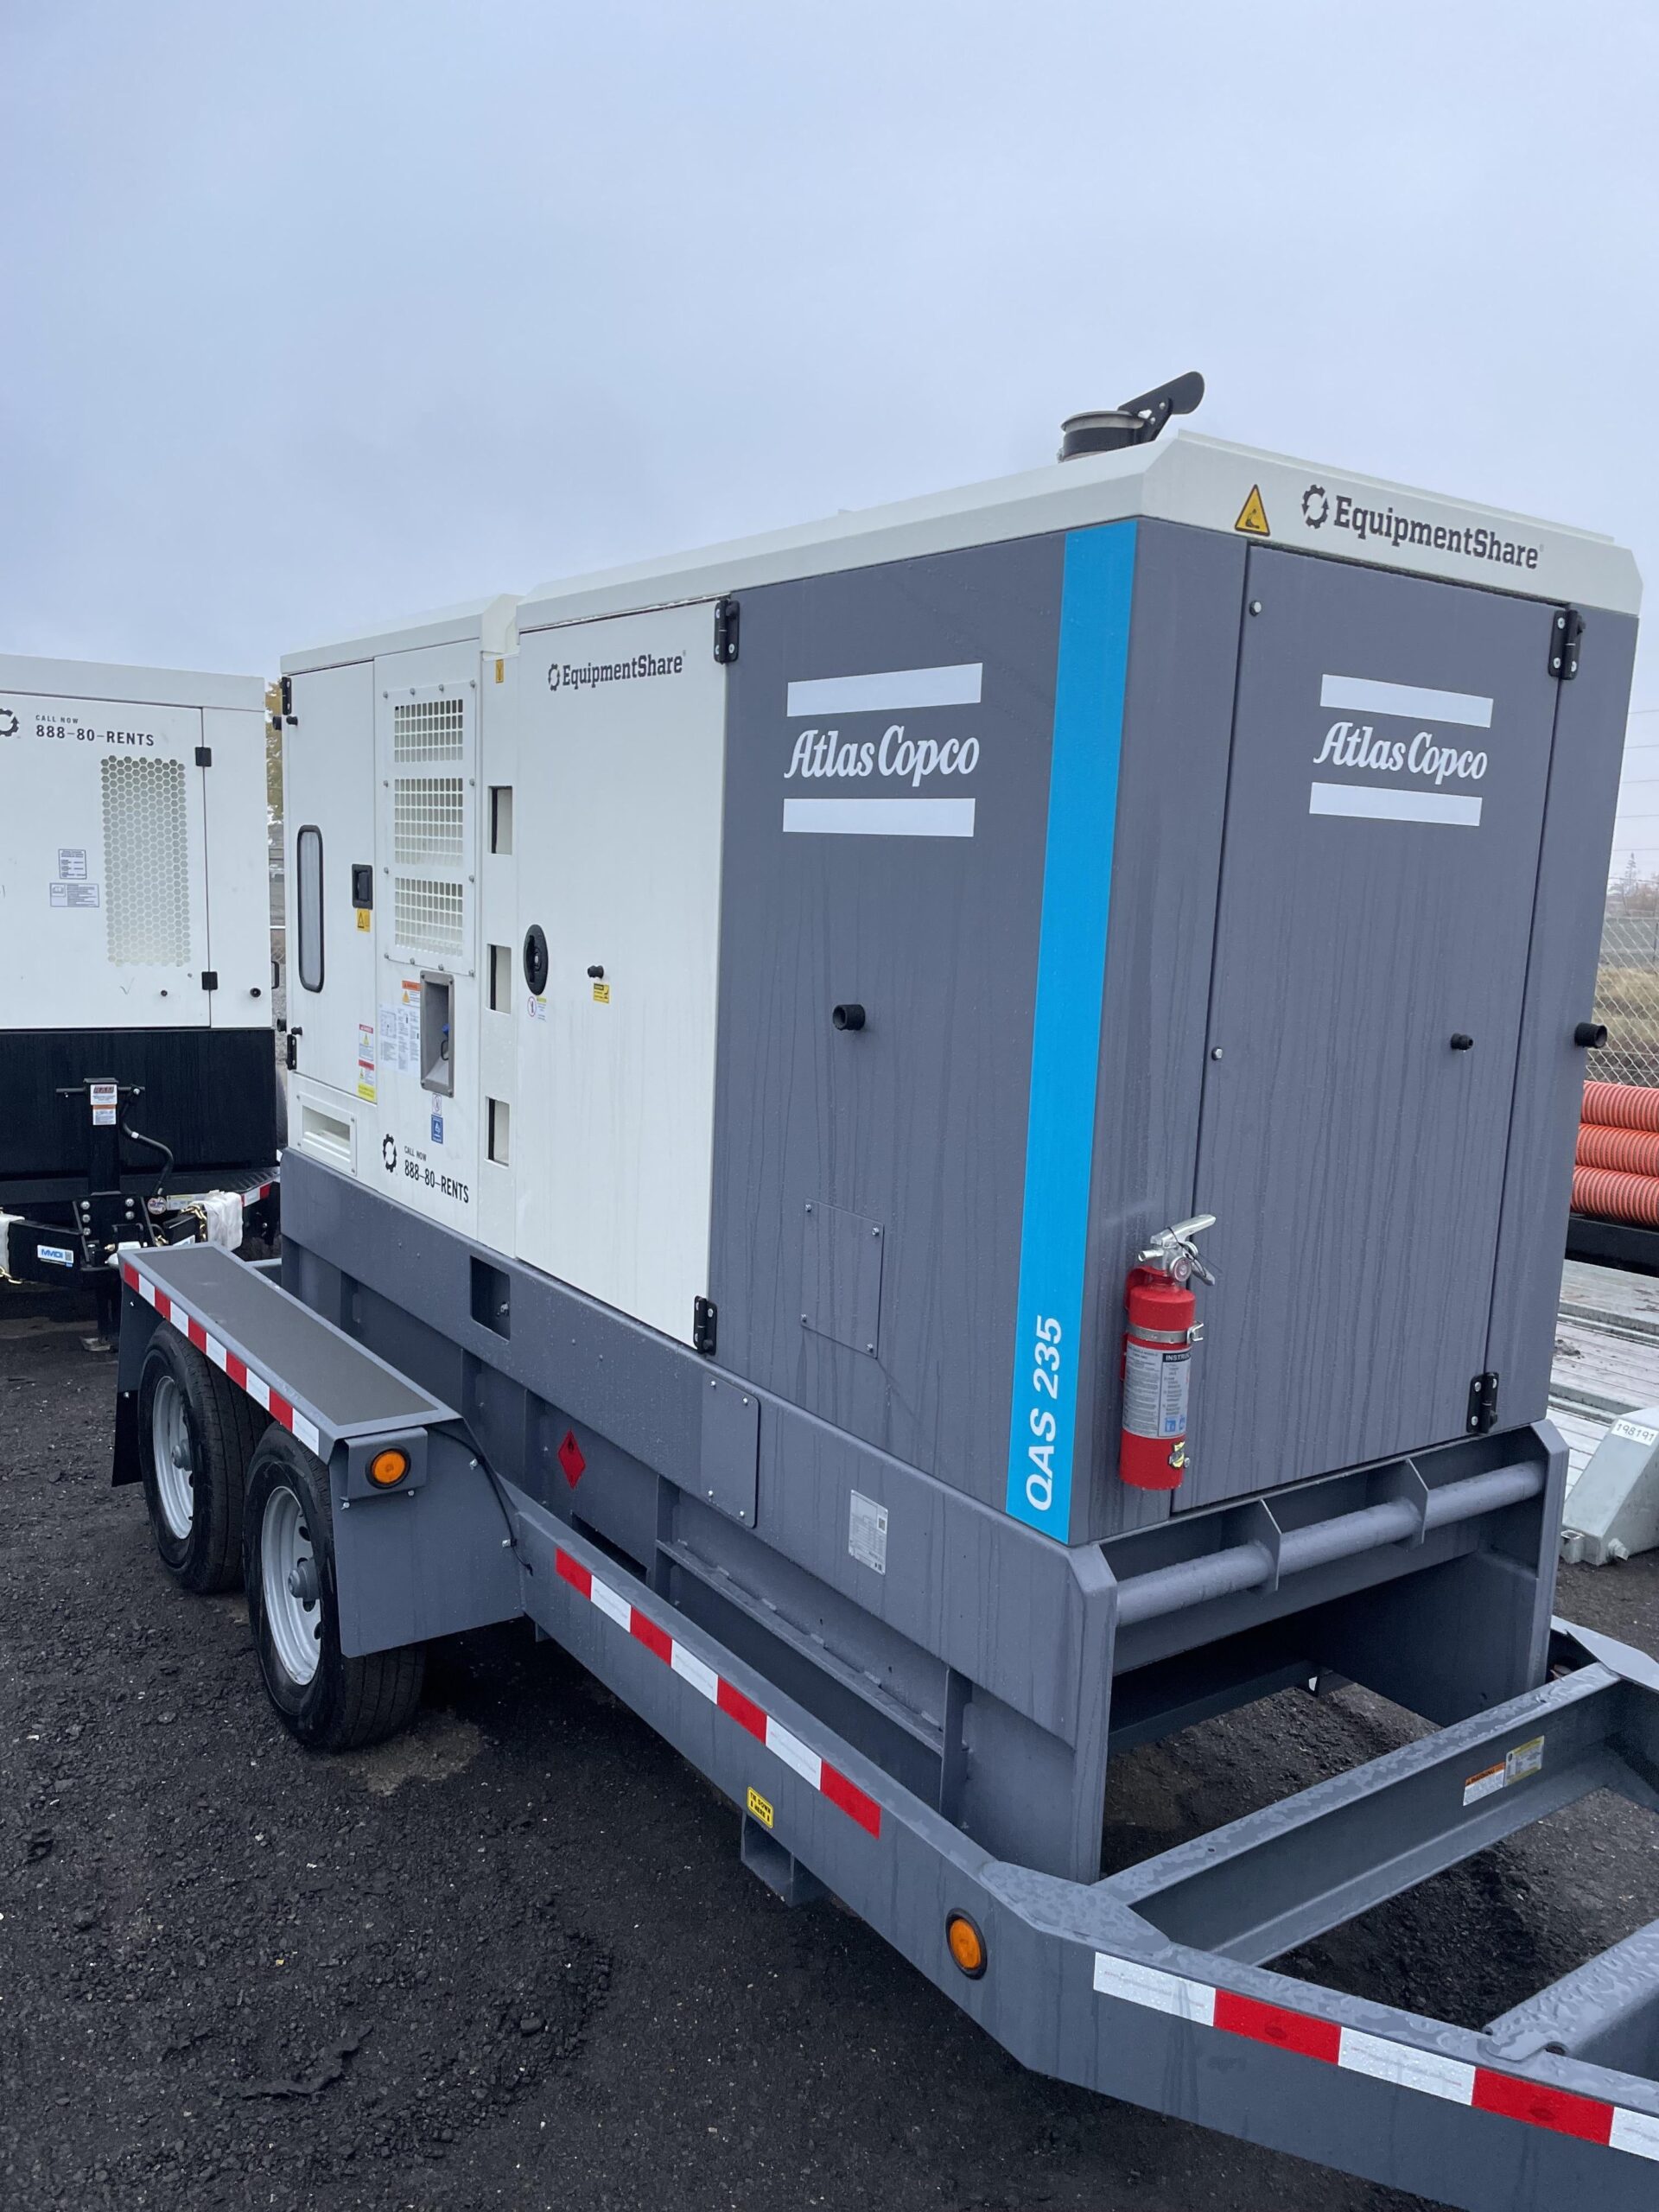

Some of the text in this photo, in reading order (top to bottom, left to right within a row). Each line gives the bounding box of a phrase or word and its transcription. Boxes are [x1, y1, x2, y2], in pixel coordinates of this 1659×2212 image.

[1333, 495, 1538, 569] EquipmentShare
[562, 653, 683, 690] EquipmentShare
[36, 724, 155, 747] 888-80-RENTS
[784, 724, 980, 787] Atlas Copco
[1313, 721, 1488, 785] Atlas Copco
[404, 1145, 427, 1161] CALL NOW
[404, 1159, 469, 1204] 888-80-RENTS
[1026, 1315, 1062, 1511] QAS 235
[1617, 1423, 1655, 1441] 198191
